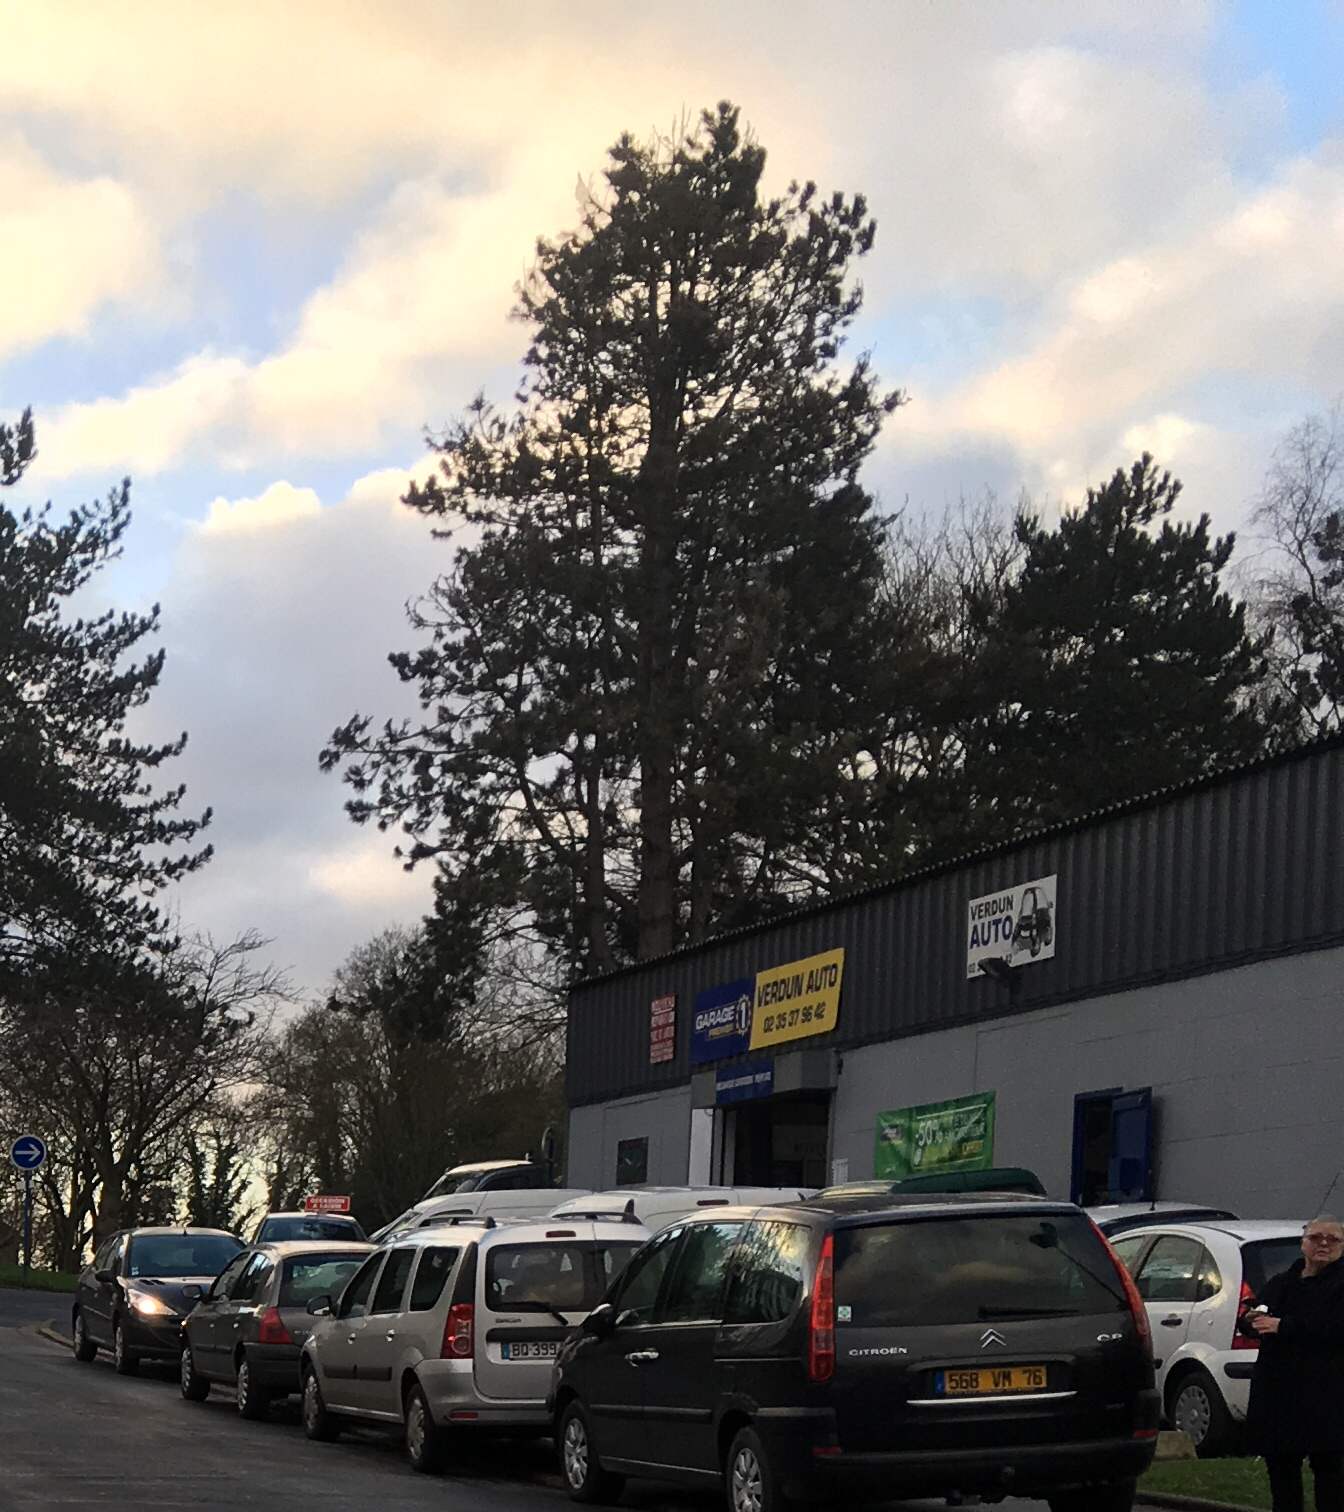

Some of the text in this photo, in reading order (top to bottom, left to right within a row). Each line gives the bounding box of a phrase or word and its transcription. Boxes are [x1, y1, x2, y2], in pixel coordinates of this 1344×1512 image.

[970, 895, 1014, 922] VERDUN
[970, 915, 1013, 949] AUTO
[758, 963, 838, 1008] VERDUN AUTO
[696, 1006, 735, 1030] GARAGE
[763, 1002, 826, 1033] 02 35 37 96 42
[948, 1368, 1043, 1390] 568 VM 76
